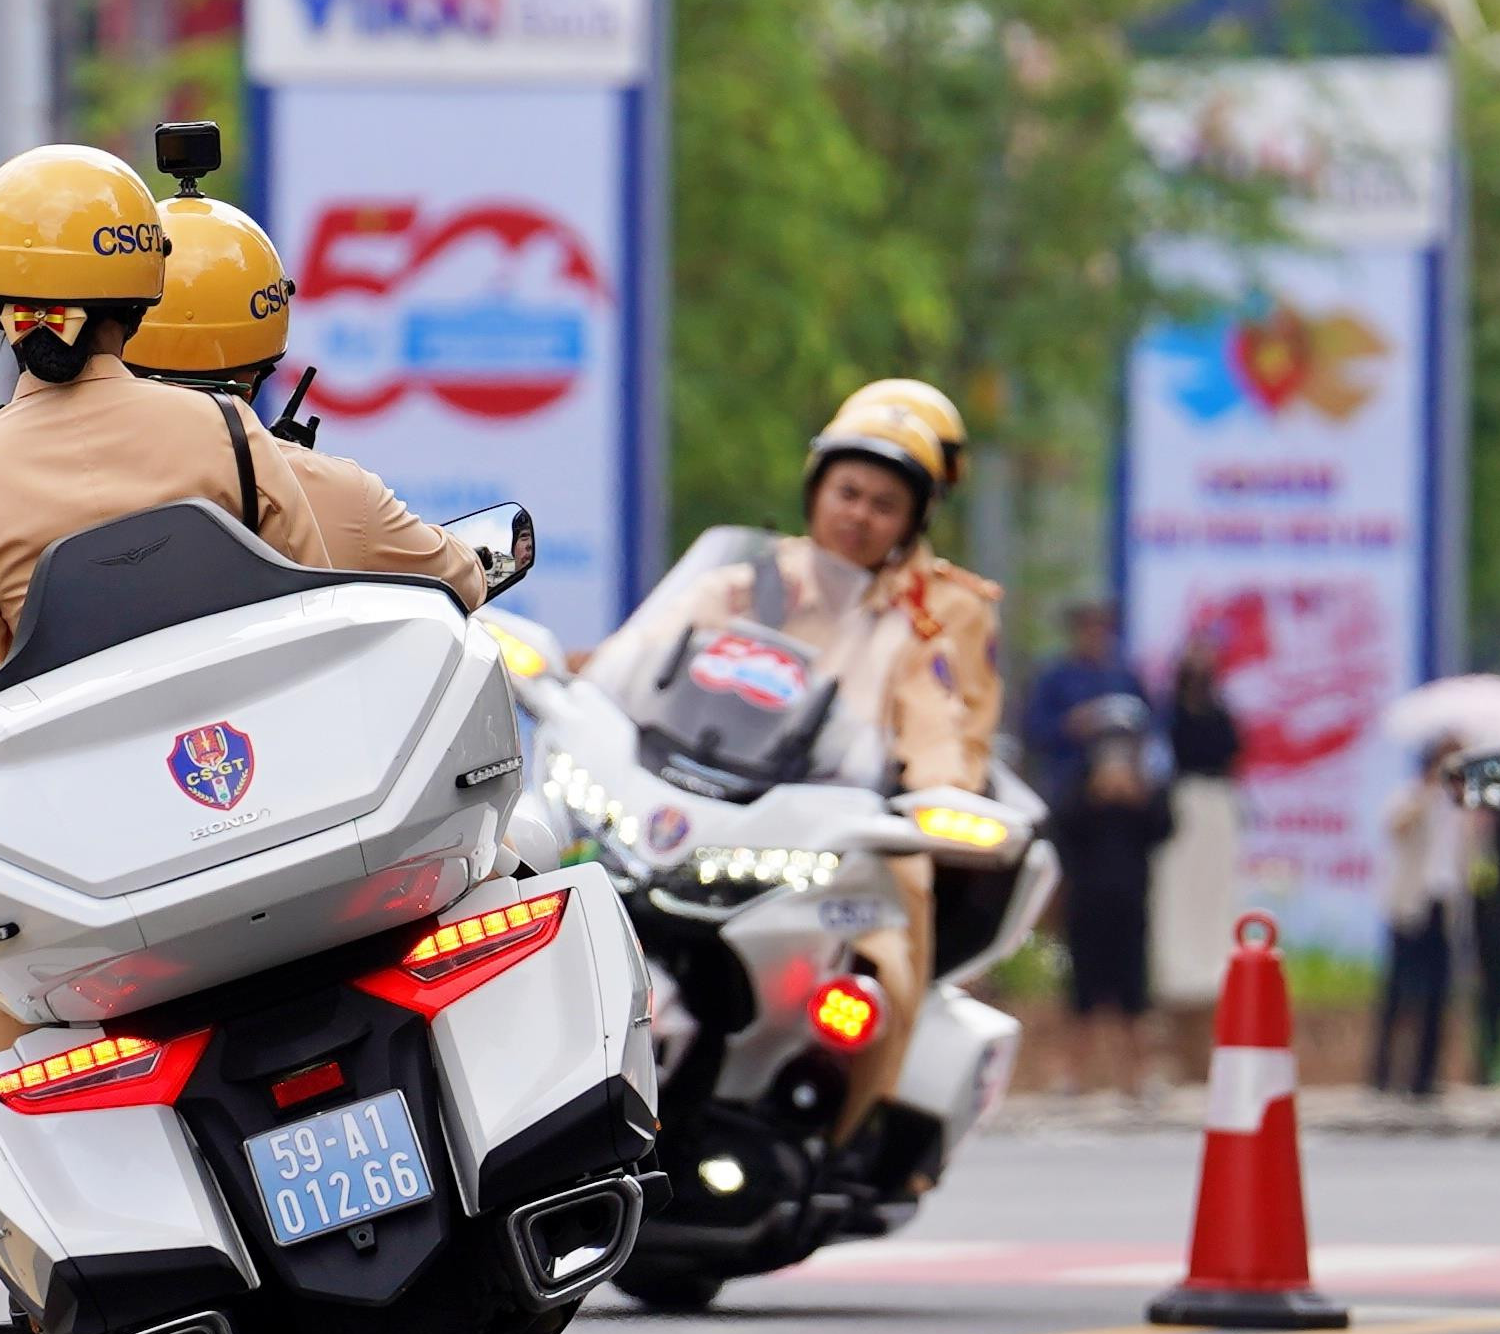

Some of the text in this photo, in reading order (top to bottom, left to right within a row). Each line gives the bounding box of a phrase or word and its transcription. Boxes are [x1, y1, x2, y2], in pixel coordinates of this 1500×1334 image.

[93, 223, 163, 256] CSGT
[186, 757, 245, 786] CSGT
[269, 1104, 389, 1180] 59-A1
[276, 1152, 419, 1234] 012.66
